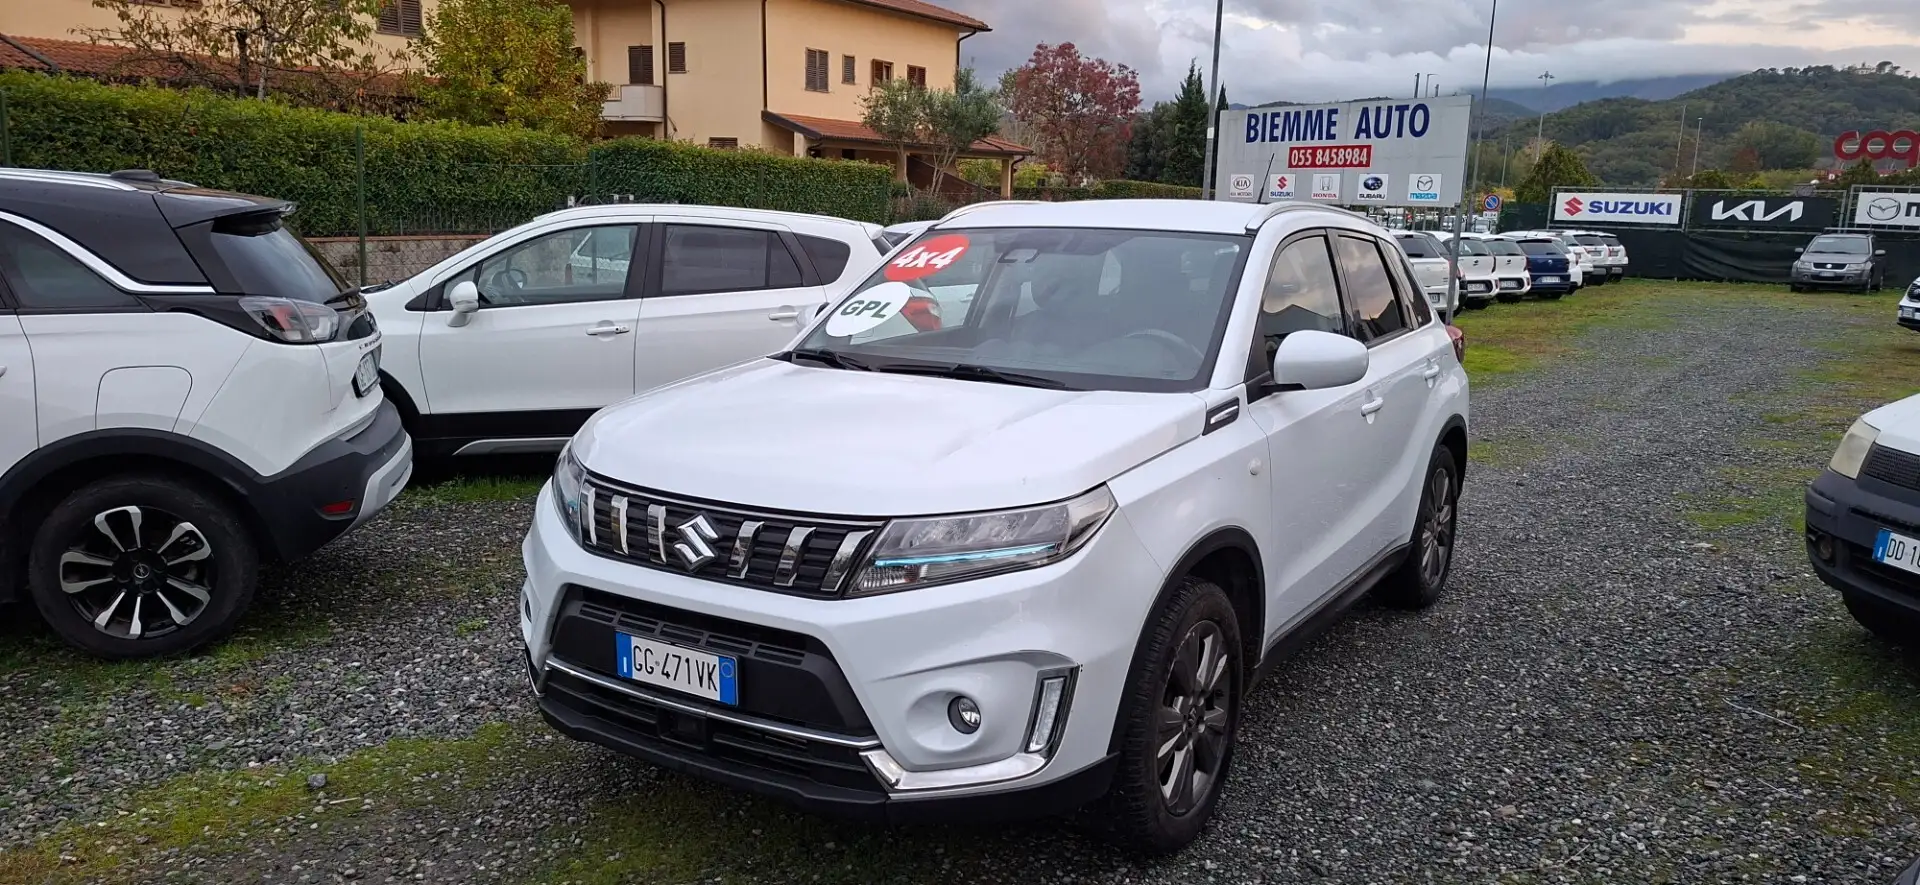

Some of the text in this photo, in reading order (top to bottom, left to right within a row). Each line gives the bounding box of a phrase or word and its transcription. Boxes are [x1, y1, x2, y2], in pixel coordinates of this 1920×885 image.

[1245, 103, 1430, 144] BIEMME AUTO
[1291, 147, 1368, 166] 055 8458984
[1588, 200, 1672, 216] SUZUKI
[840, 300, 891, 319] GPL
